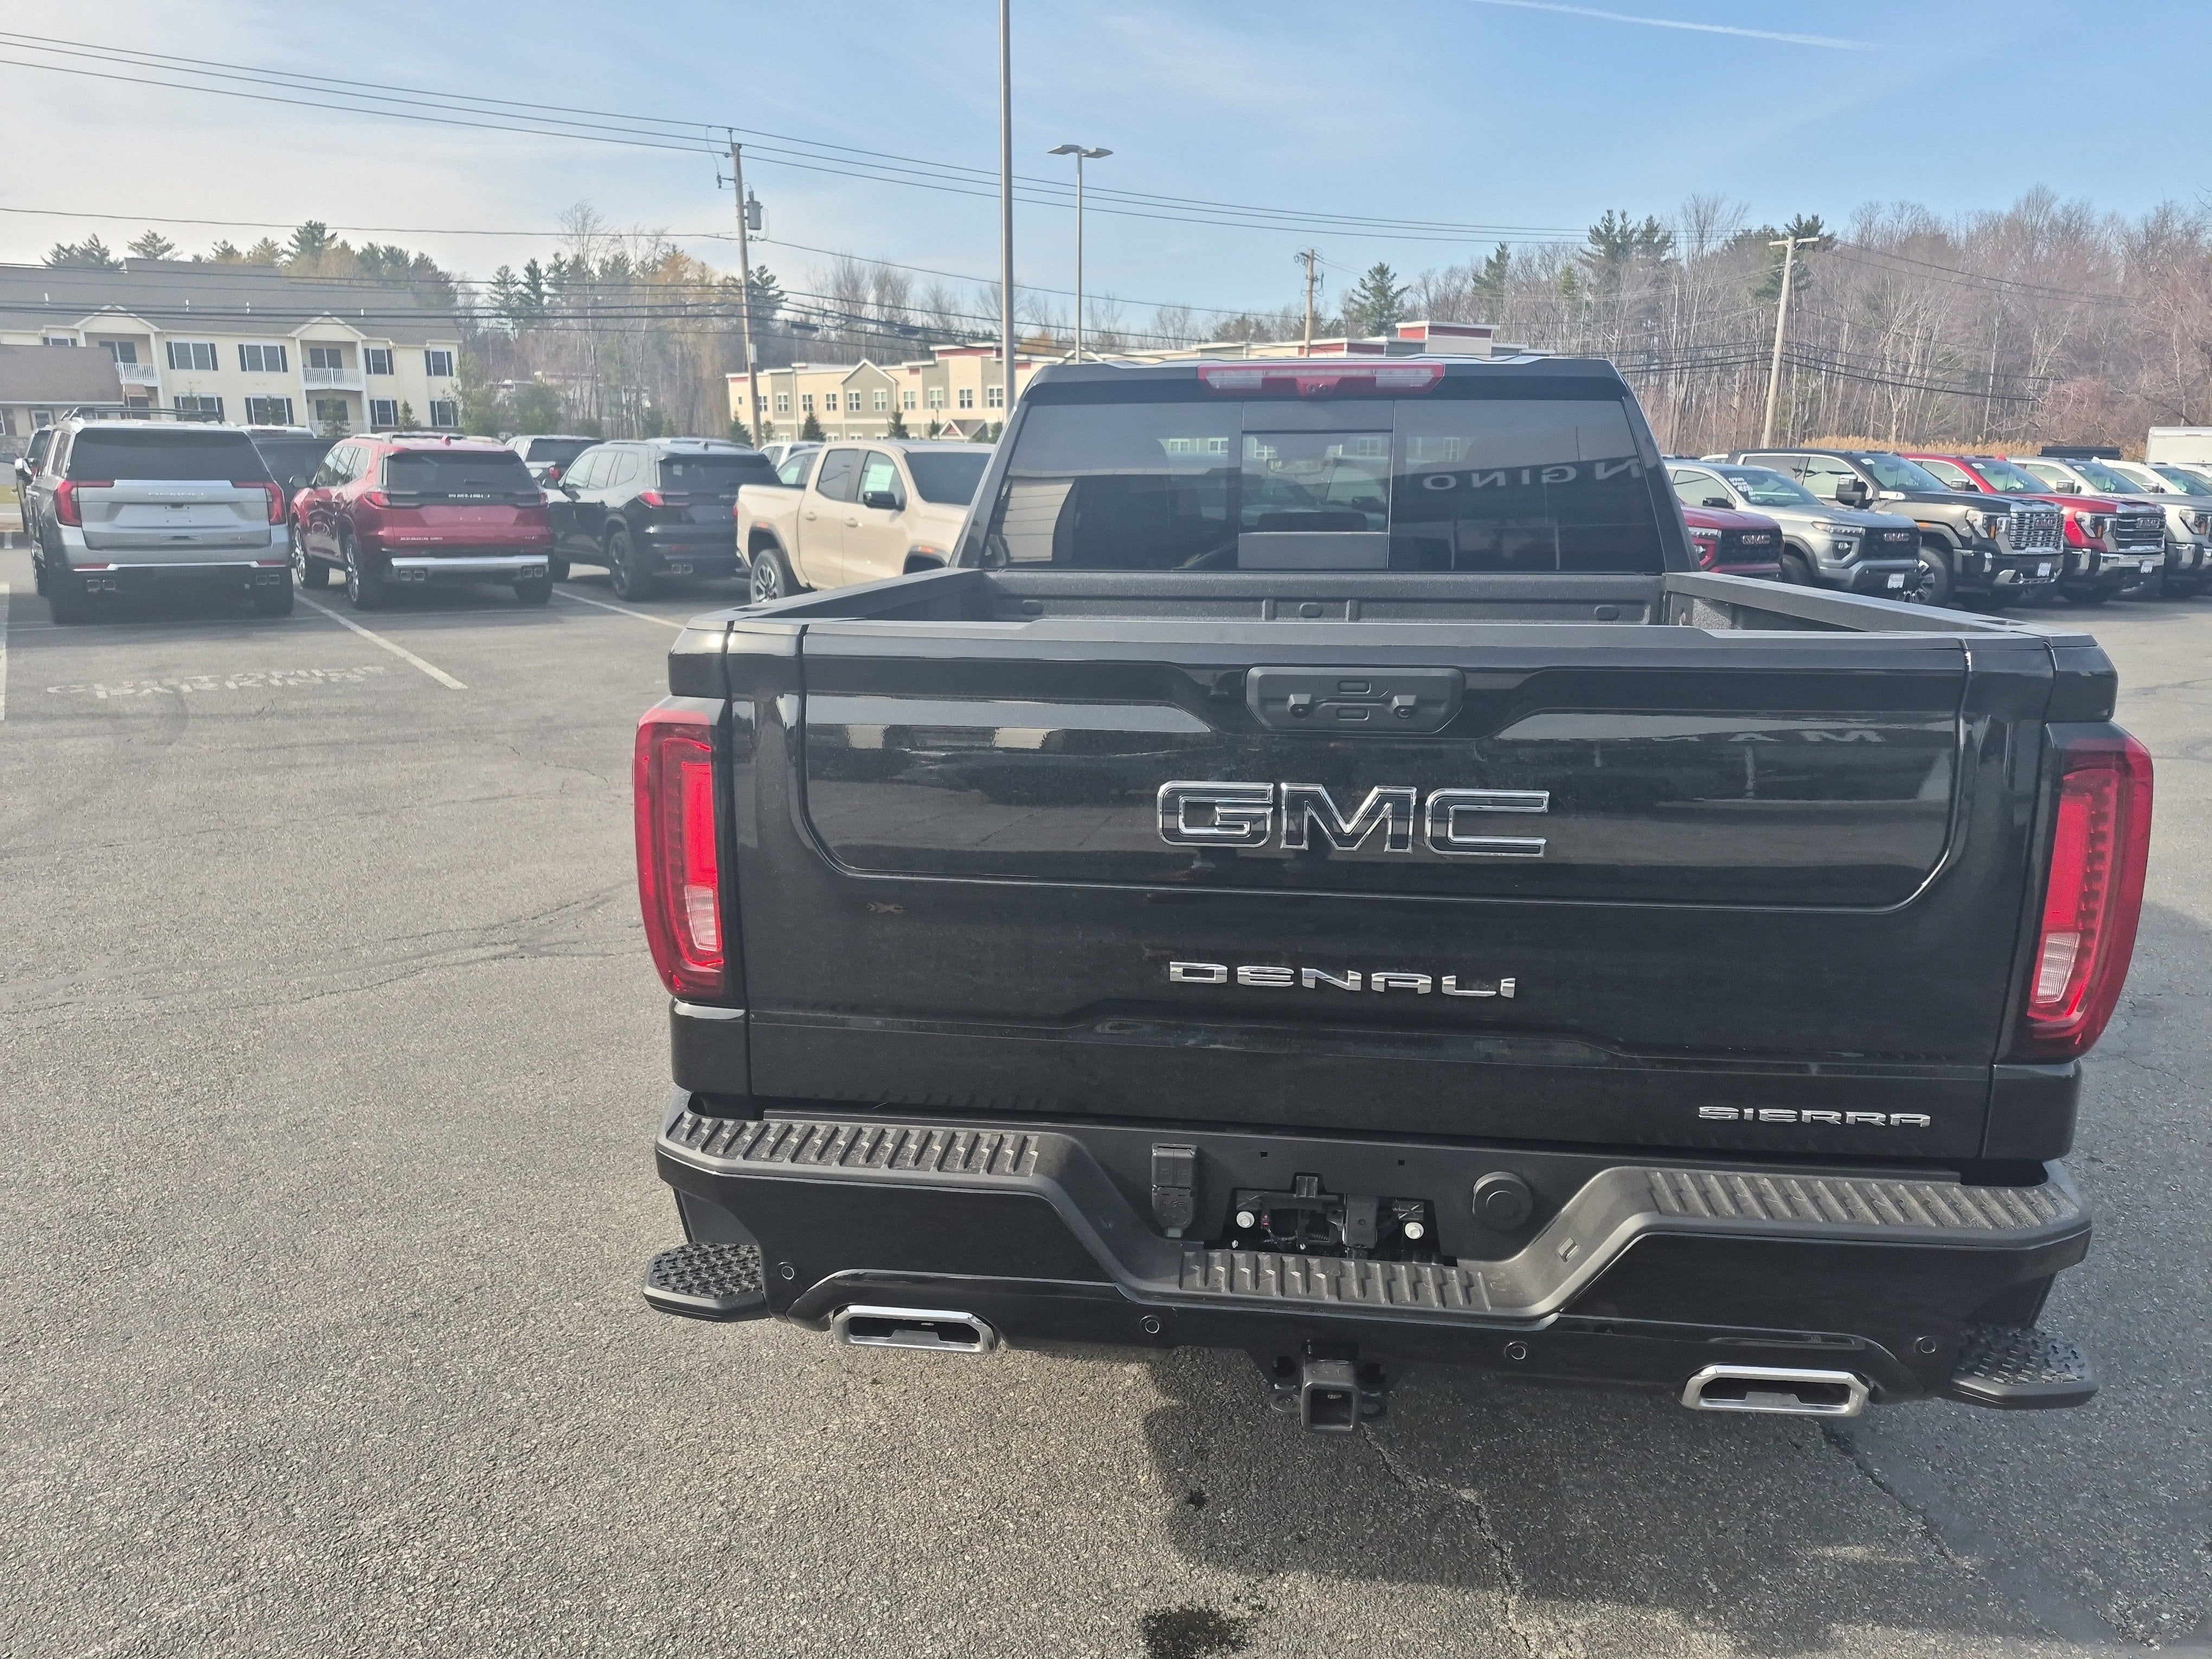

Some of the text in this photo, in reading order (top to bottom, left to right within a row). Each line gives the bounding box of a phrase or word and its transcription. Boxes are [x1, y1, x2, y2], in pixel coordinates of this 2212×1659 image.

[1742, 534, 1771, 545] GMC
[1884, 532, 1910, 542] GMC
[1156, 780, 1550, 858] GMC
[1169, 961, 1515, 999] DENALI
[1698, 1105, 1932, 1128] SIERRA
